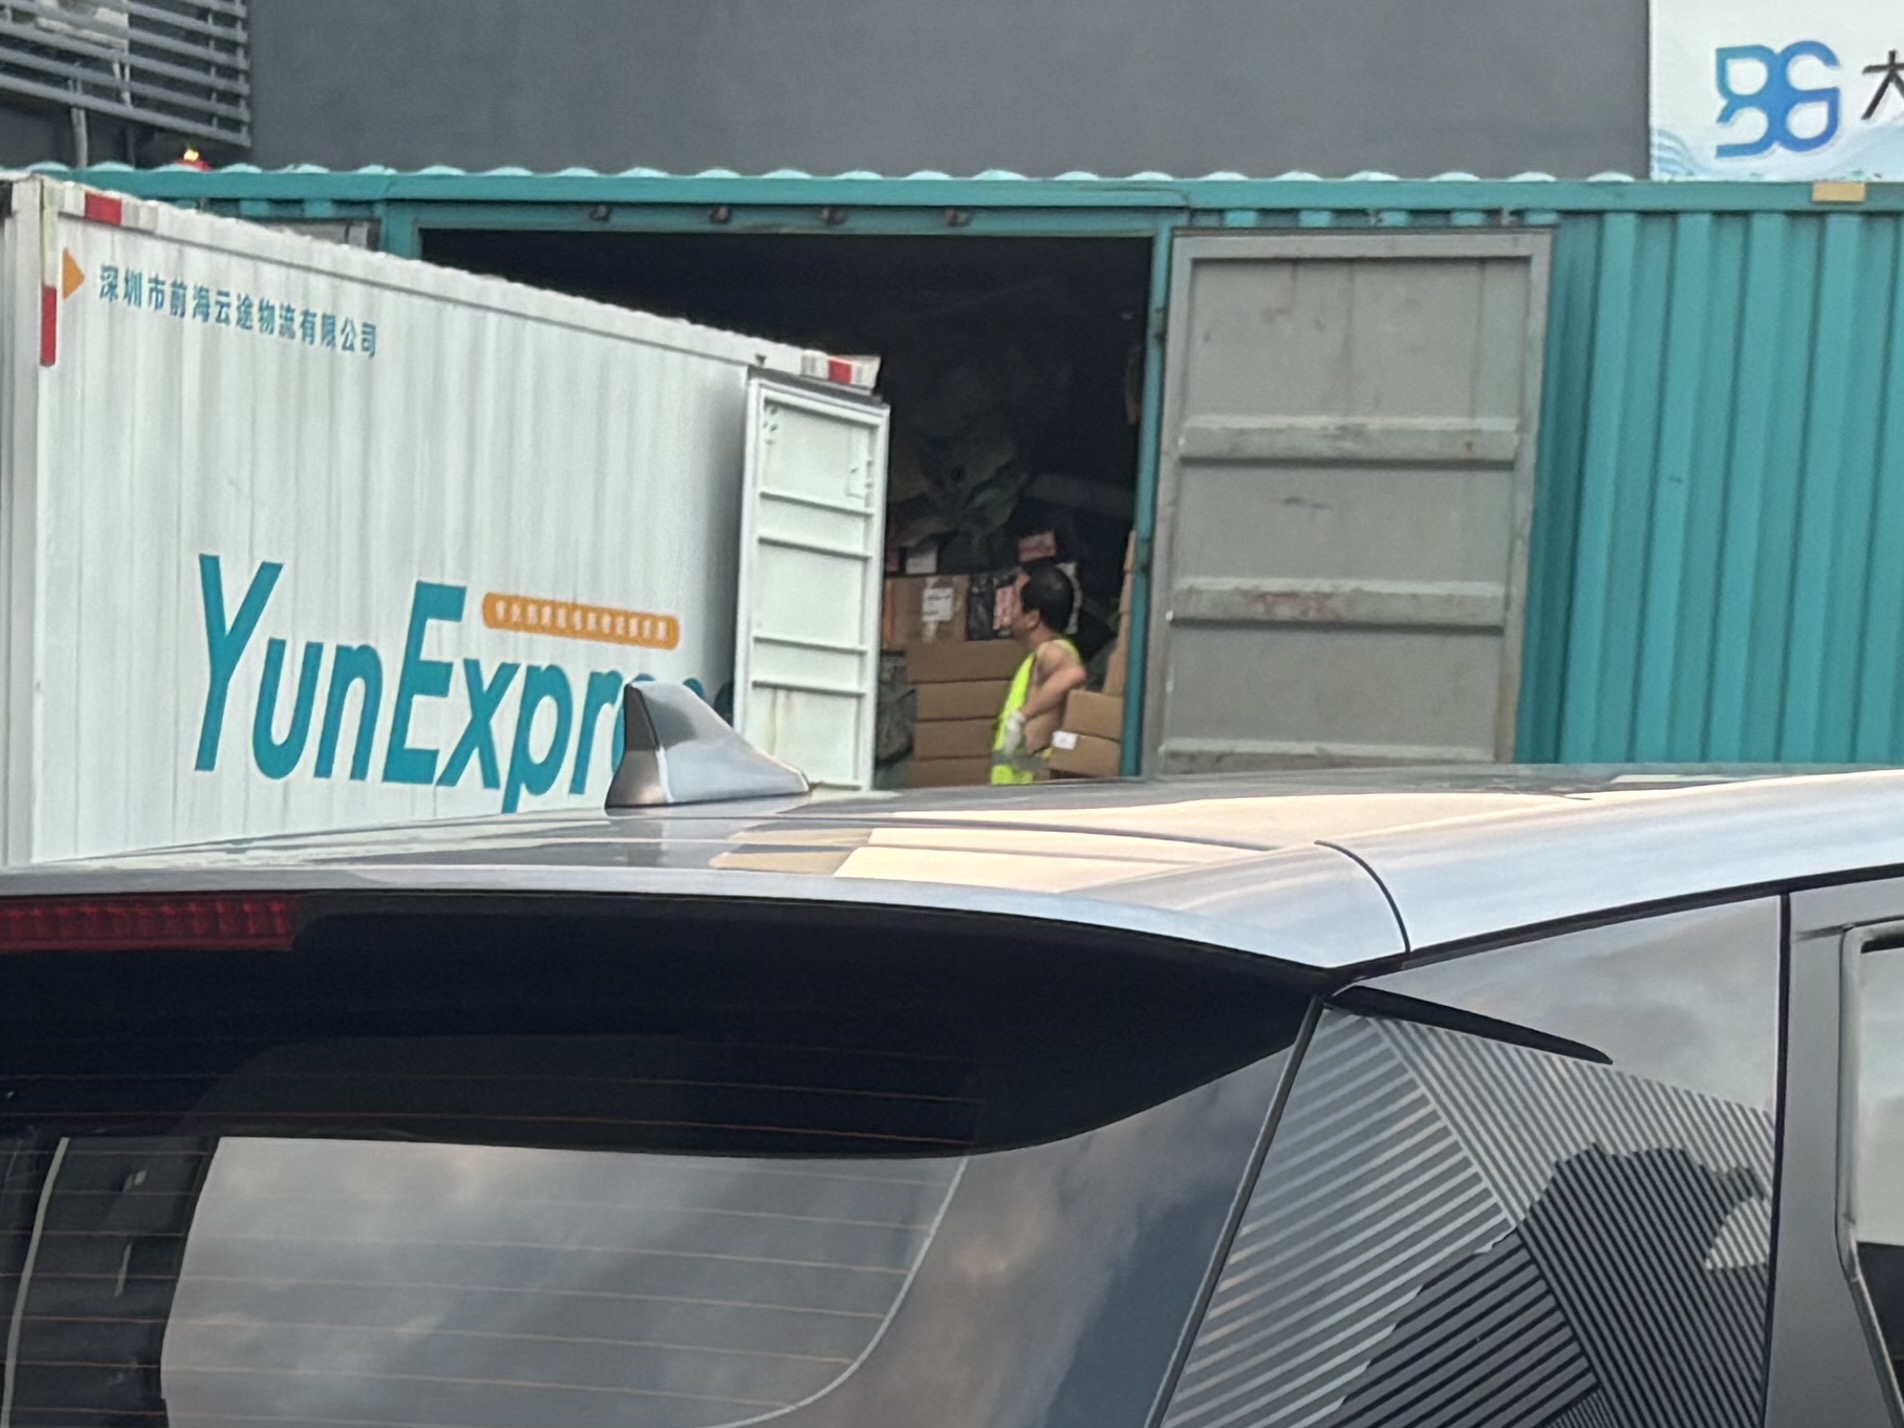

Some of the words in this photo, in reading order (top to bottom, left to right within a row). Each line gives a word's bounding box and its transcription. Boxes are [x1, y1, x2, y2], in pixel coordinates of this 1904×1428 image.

[97, 263, 379, 360] 深圳市前海云途物流有限公司
[193, 553, 735, 815] YunExpr
